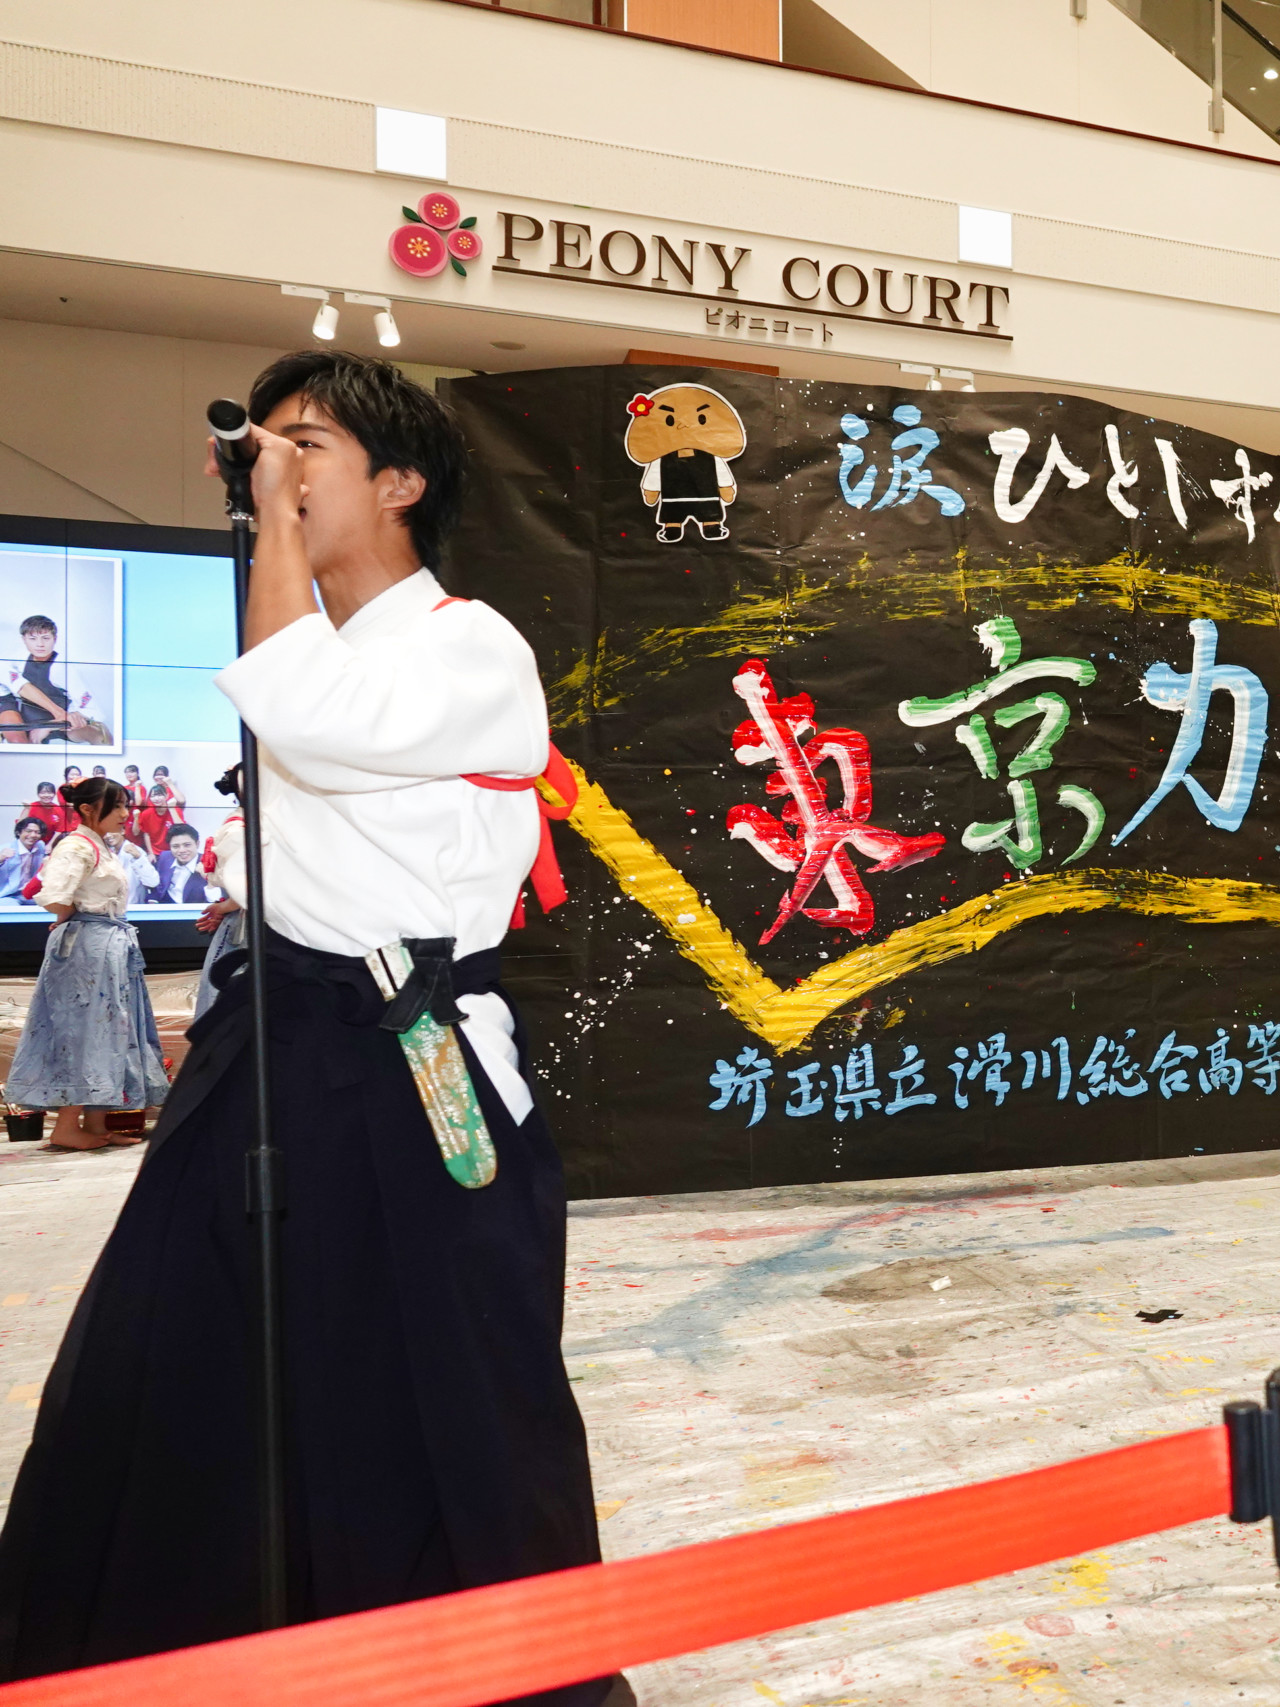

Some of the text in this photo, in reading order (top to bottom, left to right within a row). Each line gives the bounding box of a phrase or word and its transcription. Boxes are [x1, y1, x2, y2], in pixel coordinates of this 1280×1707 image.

[496, 211, 1010, 329] PEONY COURT
[704, 307, 834, 342] ピオニコート
